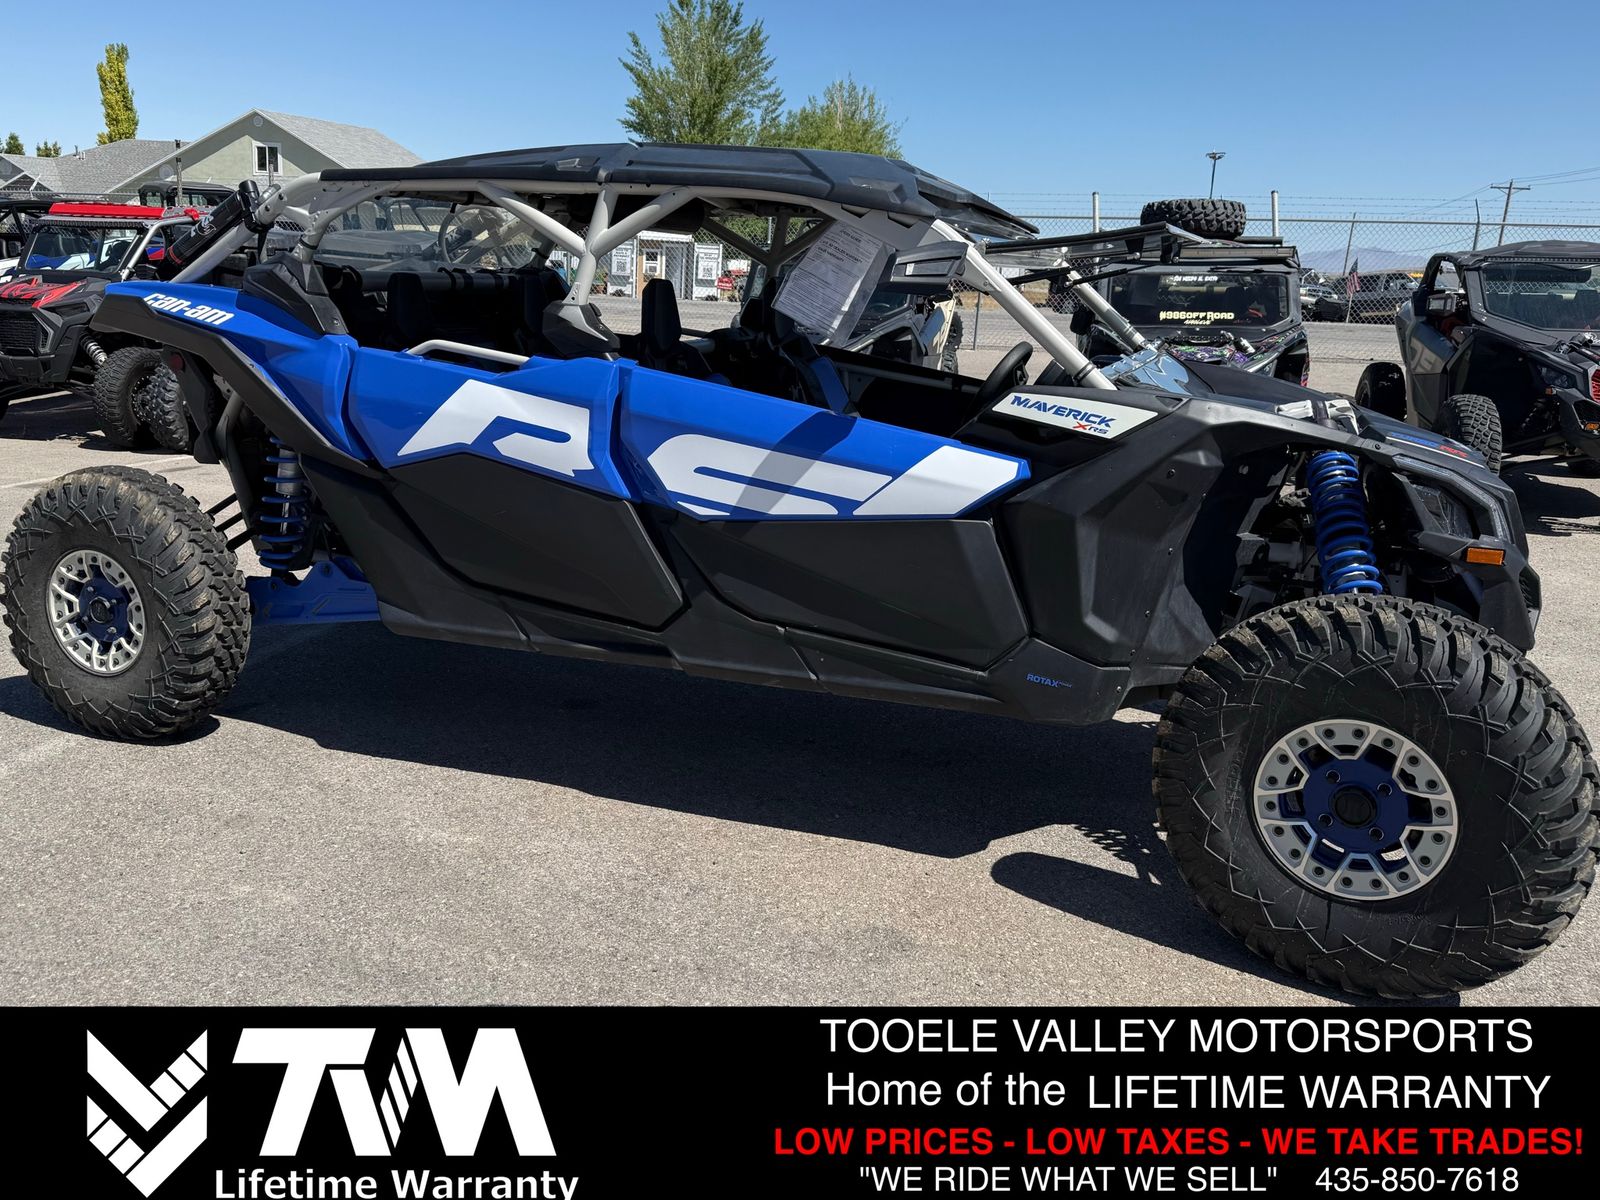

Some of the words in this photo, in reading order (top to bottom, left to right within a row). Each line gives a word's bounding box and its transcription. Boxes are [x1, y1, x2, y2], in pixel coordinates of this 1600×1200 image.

[143, 293, 235, 326] can-am
[1010, 395, 1117, 428] MAVERICK
[1026, 673, 1058, 688] ROTAX
